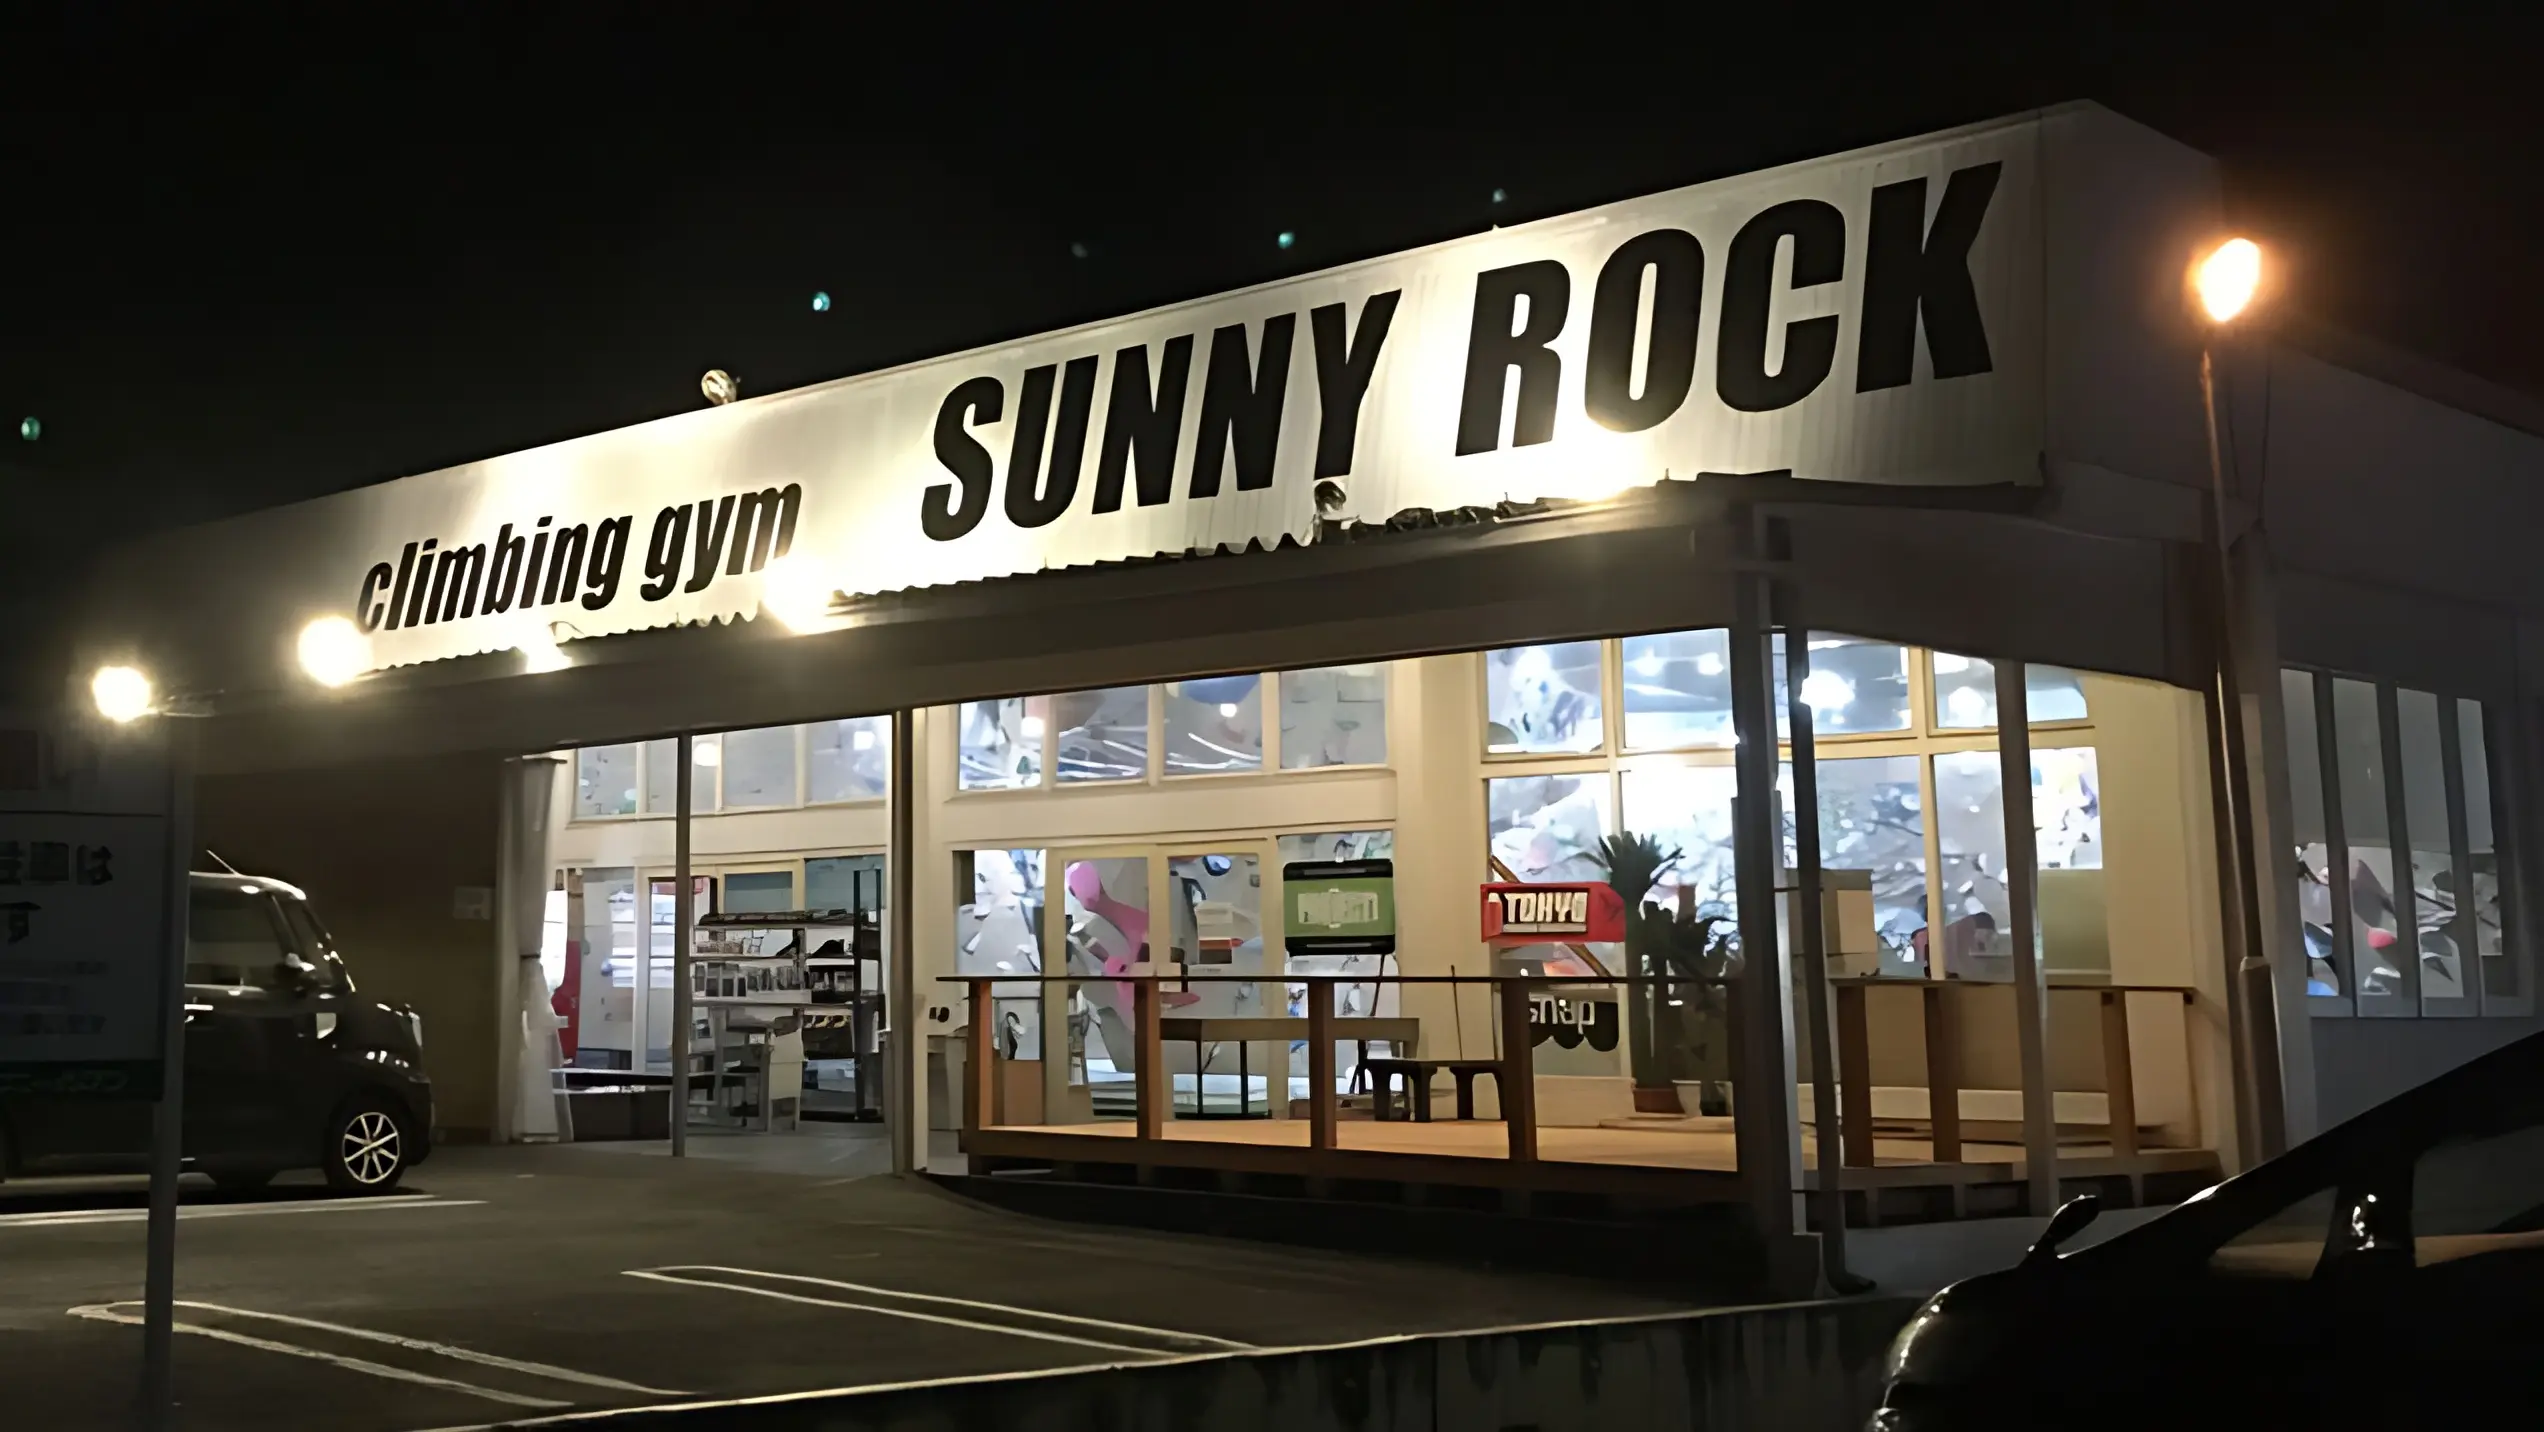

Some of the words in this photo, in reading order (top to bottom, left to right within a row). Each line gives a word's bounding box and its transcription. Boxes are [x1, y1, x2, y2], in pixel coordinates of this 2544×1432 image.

[358, 515, 633, 634] climbing
[640, 482, 803, 601] gym
[921, 289, 1402, 541] SUNNY
[1455, 160, 2002, 457] ROCK
